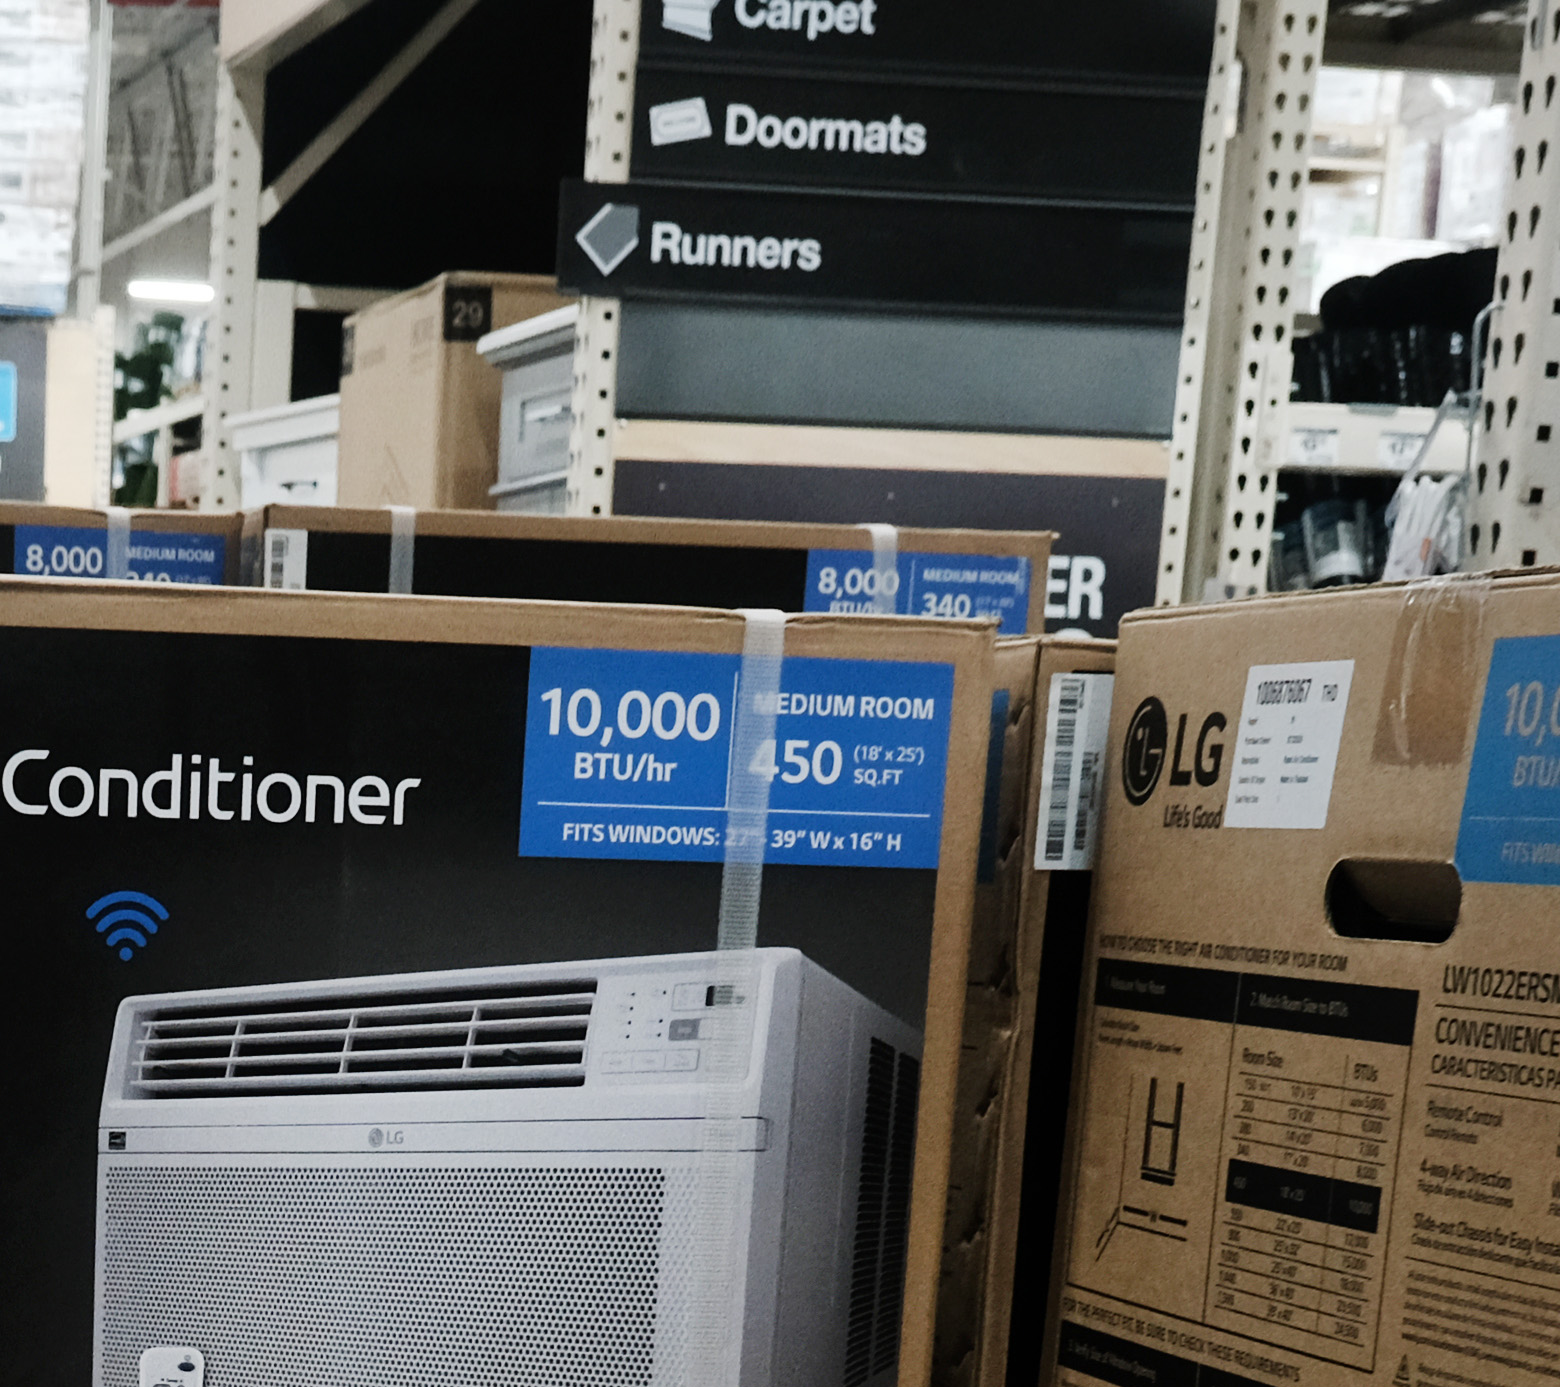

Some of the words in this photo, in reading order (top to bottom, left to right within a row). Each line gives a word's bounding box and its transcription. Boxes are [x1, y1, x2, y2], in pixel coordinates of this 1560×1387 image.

[735, 0, 876, 41] Carpet
[725, 103, 927, 156] Doormats
[651, 221, 822, 272] Runners
[452, 302, 484, 328] 29
[26, 544, 103, 576] 8,000
[178, 548, 214, 563] ROOM
[818, 567, 899, 599] 8,000
[923, 568, 976, 583] MEDIUM
[979, 570, 1019, 584] ROOM
[921, 593, 971, 618] 340
[541, 687, 721, 747] 10,000
[860, 695, 935, 720] ROOM
[748, 739, 843, 786] 450
[1169, 712, 1227, 787] LG
[574, 751, 678, 783] BTU/hr
[853, 768, 903, 787] SQ.FT
[1162, 803, 1190, 831] Life's
[1191, 802, 1224, 831] Good
[562, 823, 605, 843] FITS
[608, 824, 720, 846] WINDOWS:
[1431, 1053, 1544, 1089] CARACTERISTICAS
